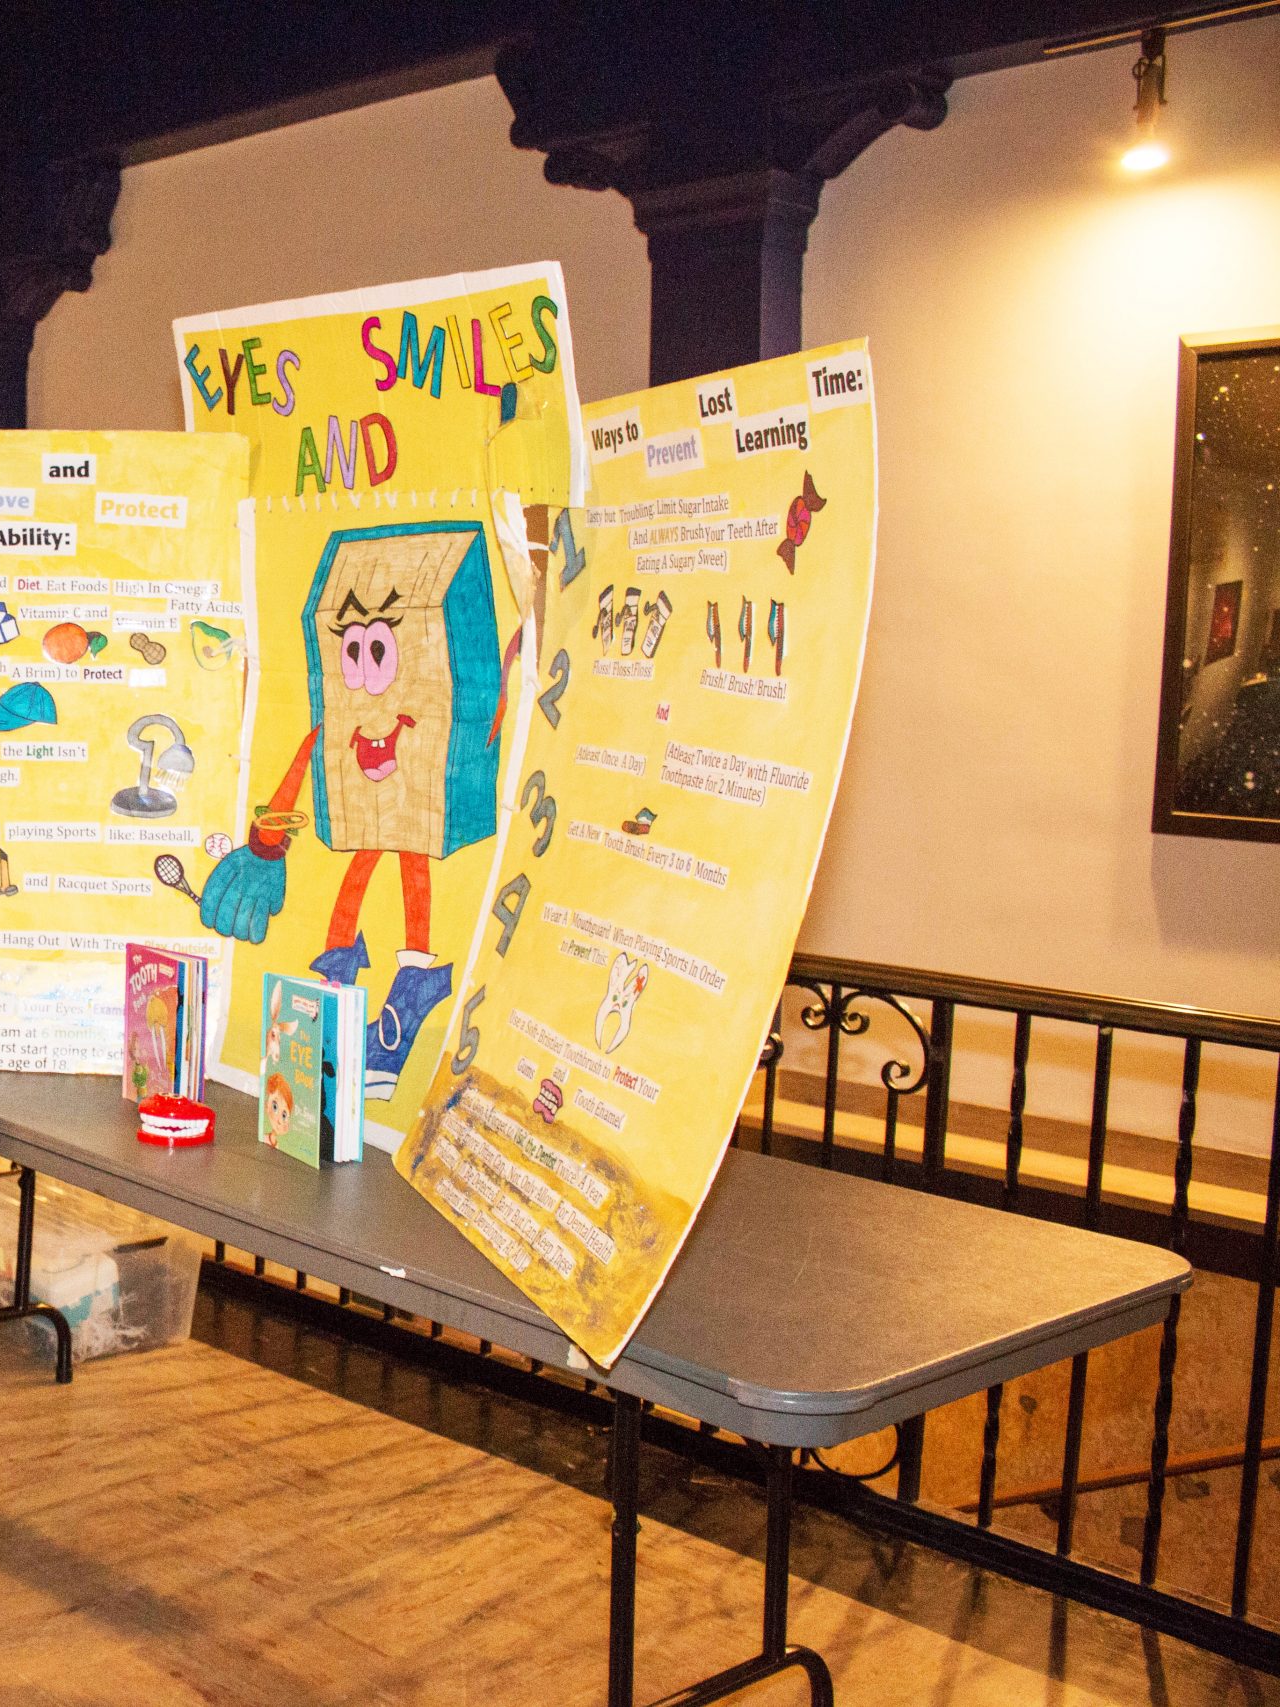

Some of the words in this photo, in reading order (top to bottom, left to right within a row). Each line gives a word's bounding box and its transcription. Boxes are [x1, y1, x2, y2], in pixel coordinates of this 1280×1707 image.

[184, 337, 300, 417] EYES
[362, 295, 558, 399] SMILES
[592, 426, 622, 453] Ways
[626, 420, 638, 440] to
[647, 436, 698, 467] Prevent
[698, 388, 732, 418] Lost
[736, 417, 808, 453] Learning
[812, 367, 863, 397] Time:
[296, 413, 397, 496] AND
[49, 461, 89, 478] and
[101, 500, 178, 519] Protect
[656, 499, 676, 514] Limit
[679, 501, 701, 518] Sugar
[702, 497, 728, 512] Intake
[650, 527, 678, 543] ALWAYS
[681, 524, 703, 541] Brush
[705, 526, 724, 542] Your
[727, 523, 752, 538] Teeth
[755, 521, 778, 536] After
[637, 556, 660, 573] Eating
[669, 555, 695, 572] Sugary
[698, 549, 727, 571] Sweet)
[47, 580, 66, 591] Eat
[71, 580, 108, 592] Foods
[149, 583, 160, 593] In
[85, 607, 108, 618] and
[171, 600, 202, 613] Fatty
[206, 601, 243, 614] Acids,
[12, 668, 20, 678] A
[26, 666, 60, 680] Brim)
[66, 668, 77, 678] to
[84, 669, 122, 679] Protect
[700, 670, 726, 688] Brush!
[757, 680, 787, 699] Brush!
[538, 648, 572, 730] 2
[656, 704, 670, 720] And
[3, 745, 22, 756] the
[27, 746, 53, 759] Light
[58, 747, 85, 757] Isn't
[696, 750, 720, 768] Twice
[729, 758, 747, 778] Day
[747, 763, 768, 781] with
[769, 767, 809, 790] Fluoride
[661, 766, 703, 789] Toothpaste
[704, 774, 717, 792] for
[725, 783, 766, 807] Minutes)
[520, 771, 557, 857] 3
[8, 826, 53, 839] playing
[57, 826, 96, 839] Sports
[109, 830, 135, 841] like:
[140, 830, 194, 842] Baseball,
[625, 839, 645, 858] Brush
[646, 846, 668, 869] Every
[694, 861, 727, 885] Months
[26, 876, 48, 887] and
[58, 878, 107, 892] Racquet
[111, 880, 151, 893] Sports
[492, 872, 531, 958] 4
[2, 933, 33, 948] Hang
[38, 935, 59, 946] Out
[70, 937, 99, 949] With
[130, 963, 157, 994] TOOTH
[663, 949, 688, 972] Sports
[699, 963, 725, 990] Order
[26, 1028, 37, 1038] at
[451, 984, 486, 1076] 5
[8, 1058, 30, 1070] age
[35, 1057, 47, 1068] of
[21, 1043, 48, 1055] start
[52, 1046, 87, 1060] going
[290, 1040, 313, 1069] EYE
[613, 1066, 638, 1090] Protect
[638, 1077, 659, 1100] Your
